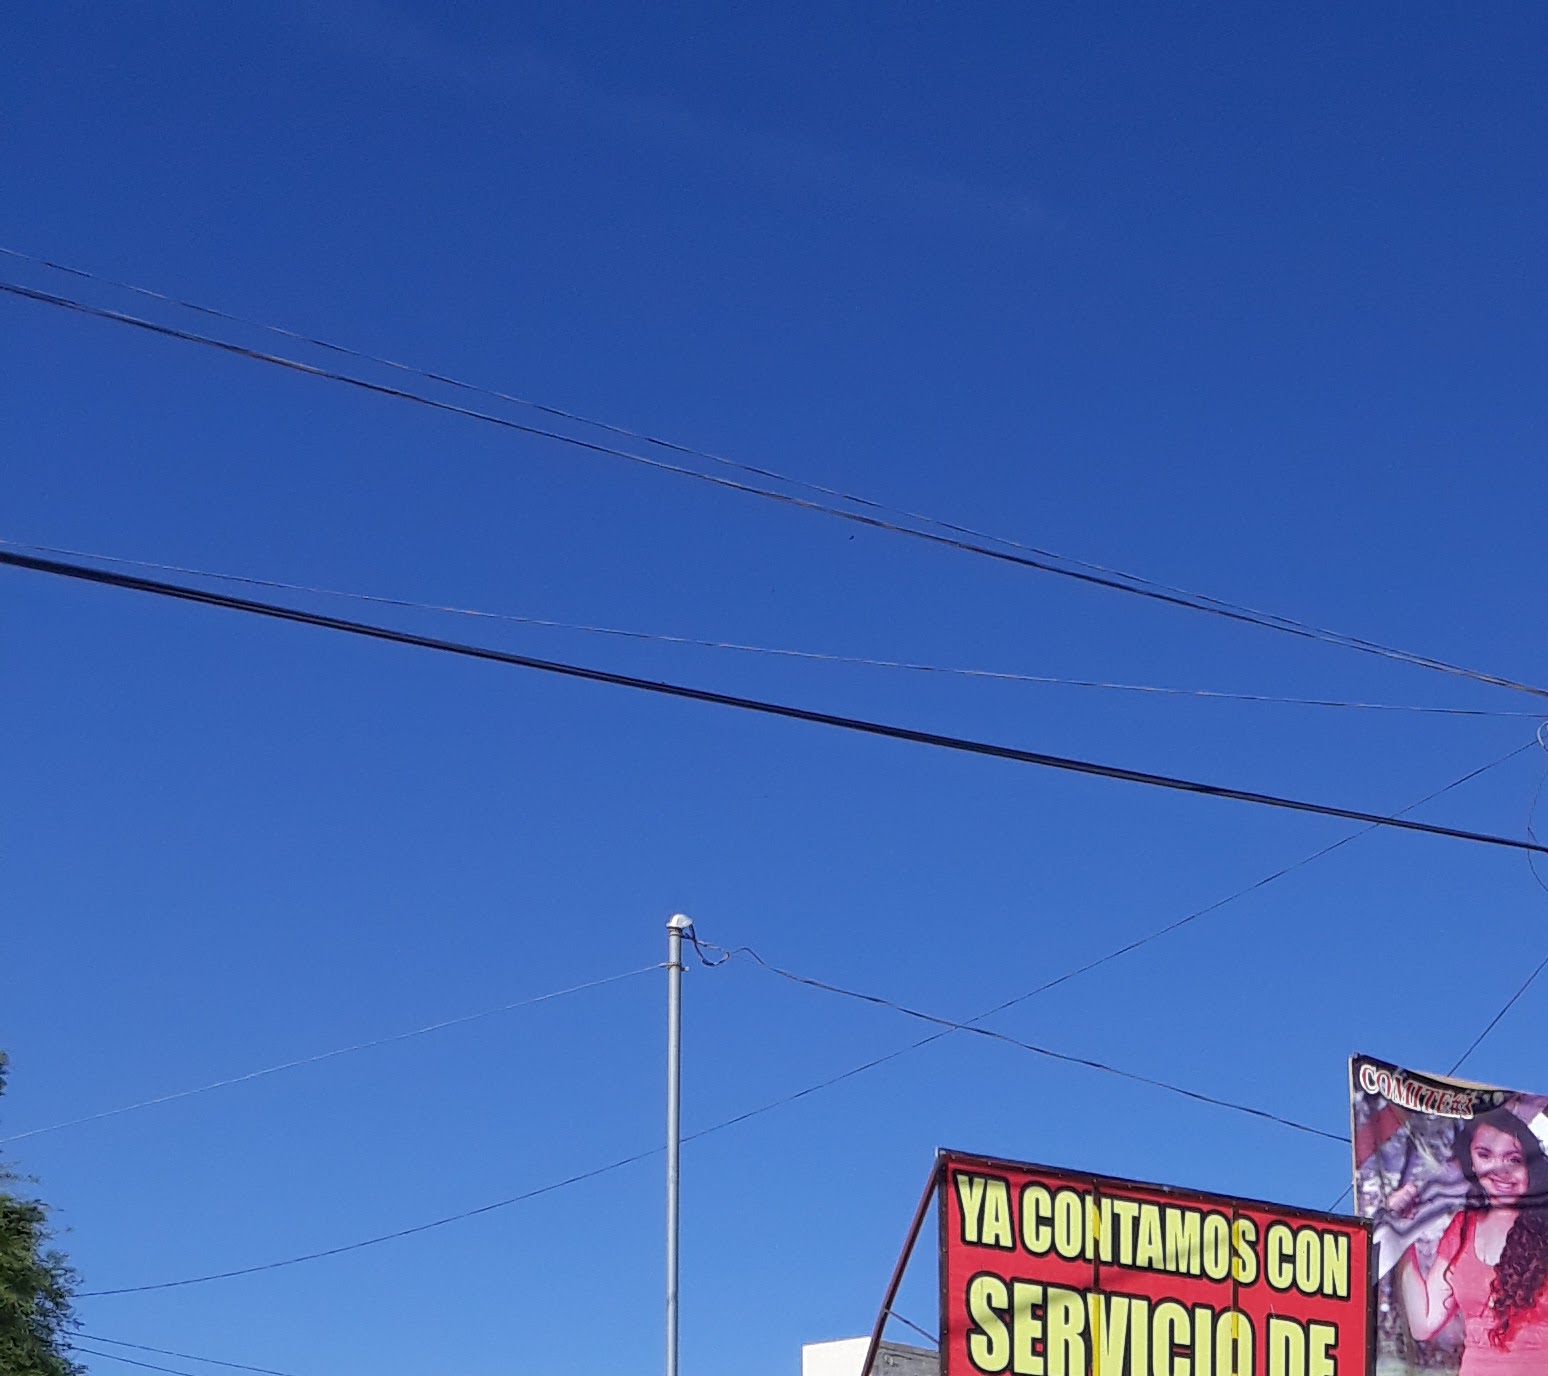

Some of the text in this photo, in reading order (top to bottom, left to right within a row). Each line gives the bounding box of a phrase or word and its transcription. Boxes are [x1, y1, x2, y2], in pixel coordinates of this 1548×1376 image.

[955, 1174, 1349, 1299] YA CONTAMOS CON
